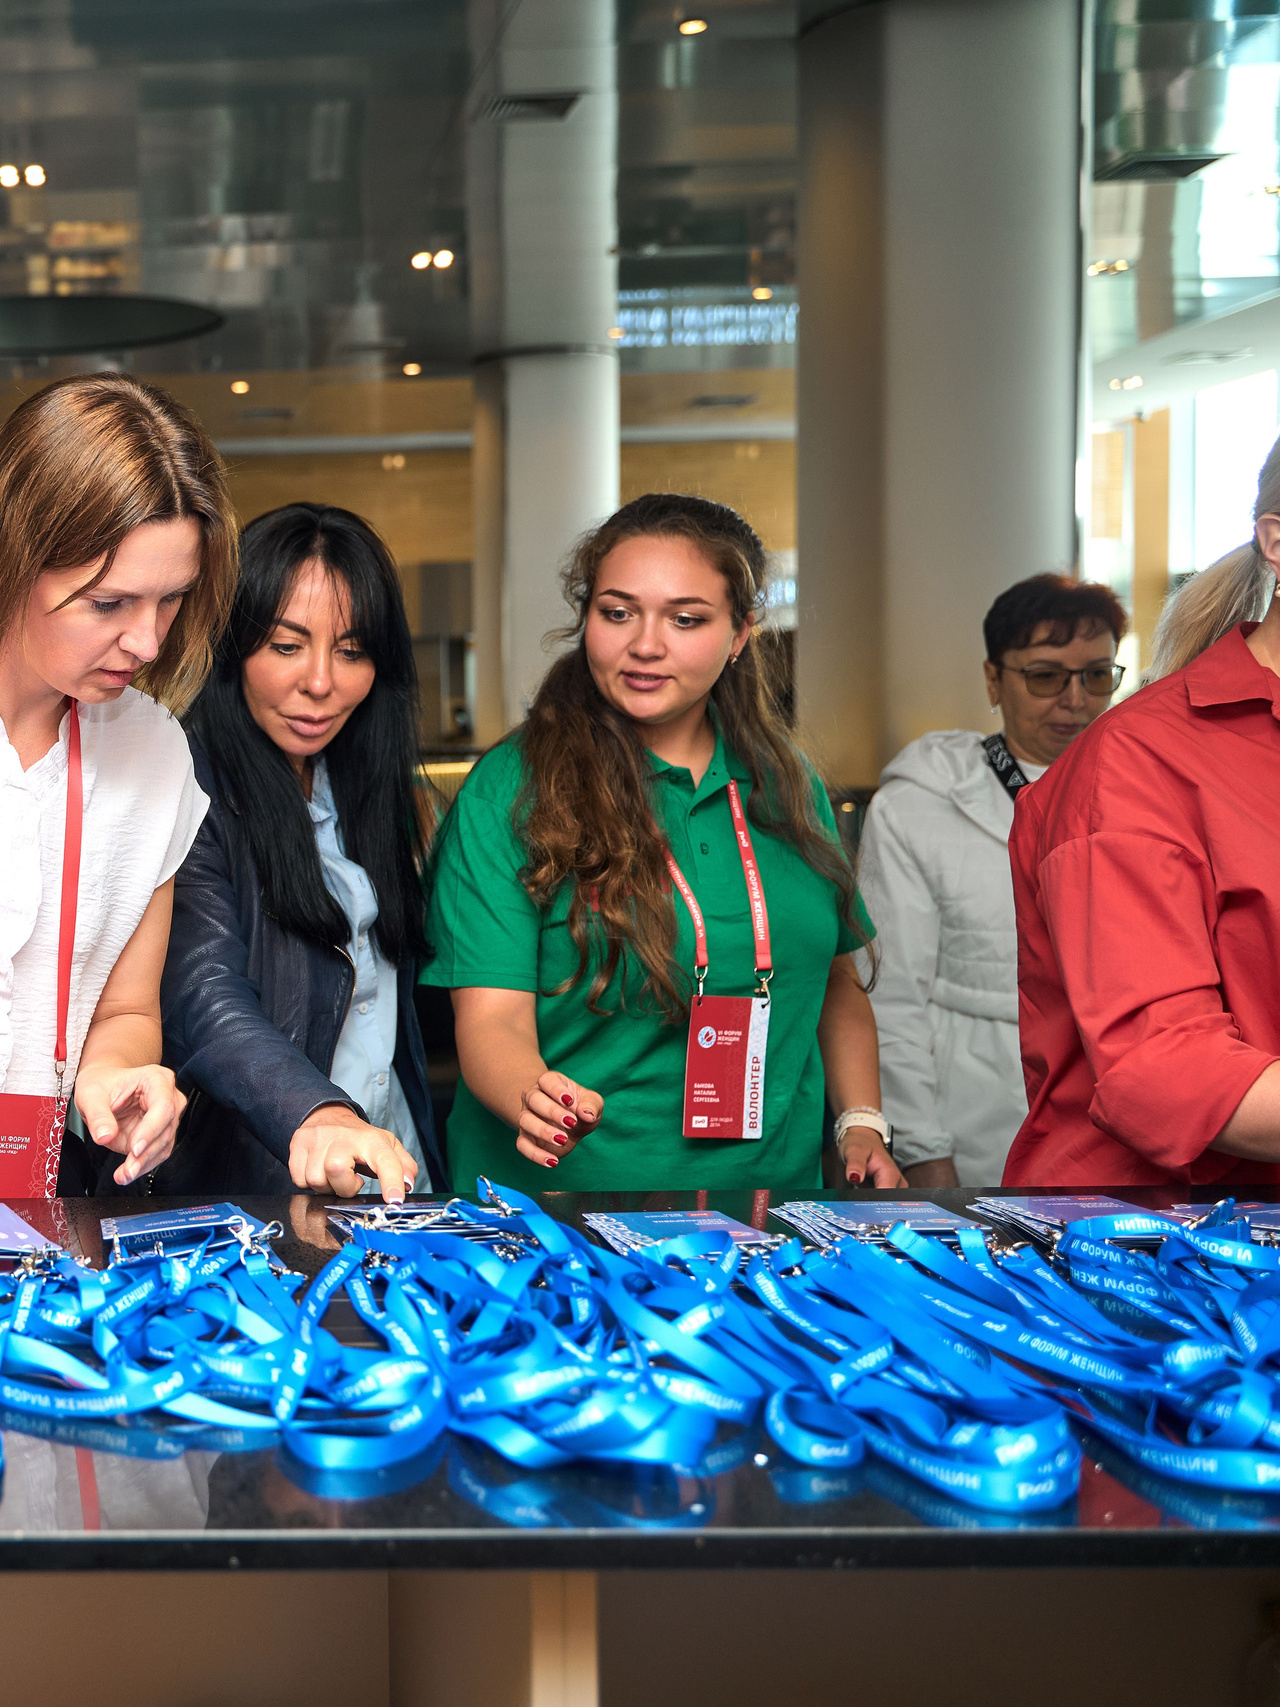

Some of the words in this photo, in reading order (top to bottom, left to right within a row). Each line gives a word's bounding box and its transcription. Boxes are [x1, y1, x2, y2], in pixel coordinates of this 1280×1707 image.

[748, 869, 761, 899] ФОРУМ
[686, 895, 702, 927] ФОРУМ
[754, 901, 766, 940] ЖЕНЩИН
[749, 1056, 761, 1129] ВОЛОНТЕР
[1114, 1217, 1181, 1235] ЖЕНЩИН
[1071, 1239, 1079, 1249] VI
[1081, 1241, 1121, 1263] ФОРУМ
[1184, 1230, 1232, 1258] ФОРУМ
[1237, 1248, 1253, 1261] VI
[115, 1280, 156, 1311] ЖЕНЩИН
[1104, 1277, 1158, 1297] ФОРУМ
[1018, 1332, 1030, 1344] VI
[1030, 1337, 1068, 1361] ФОРУМ
[1069, 1352, 1123, 1382] ЖЕНЩИН
[3, 1386, 51, 1408] ФОРУМ
